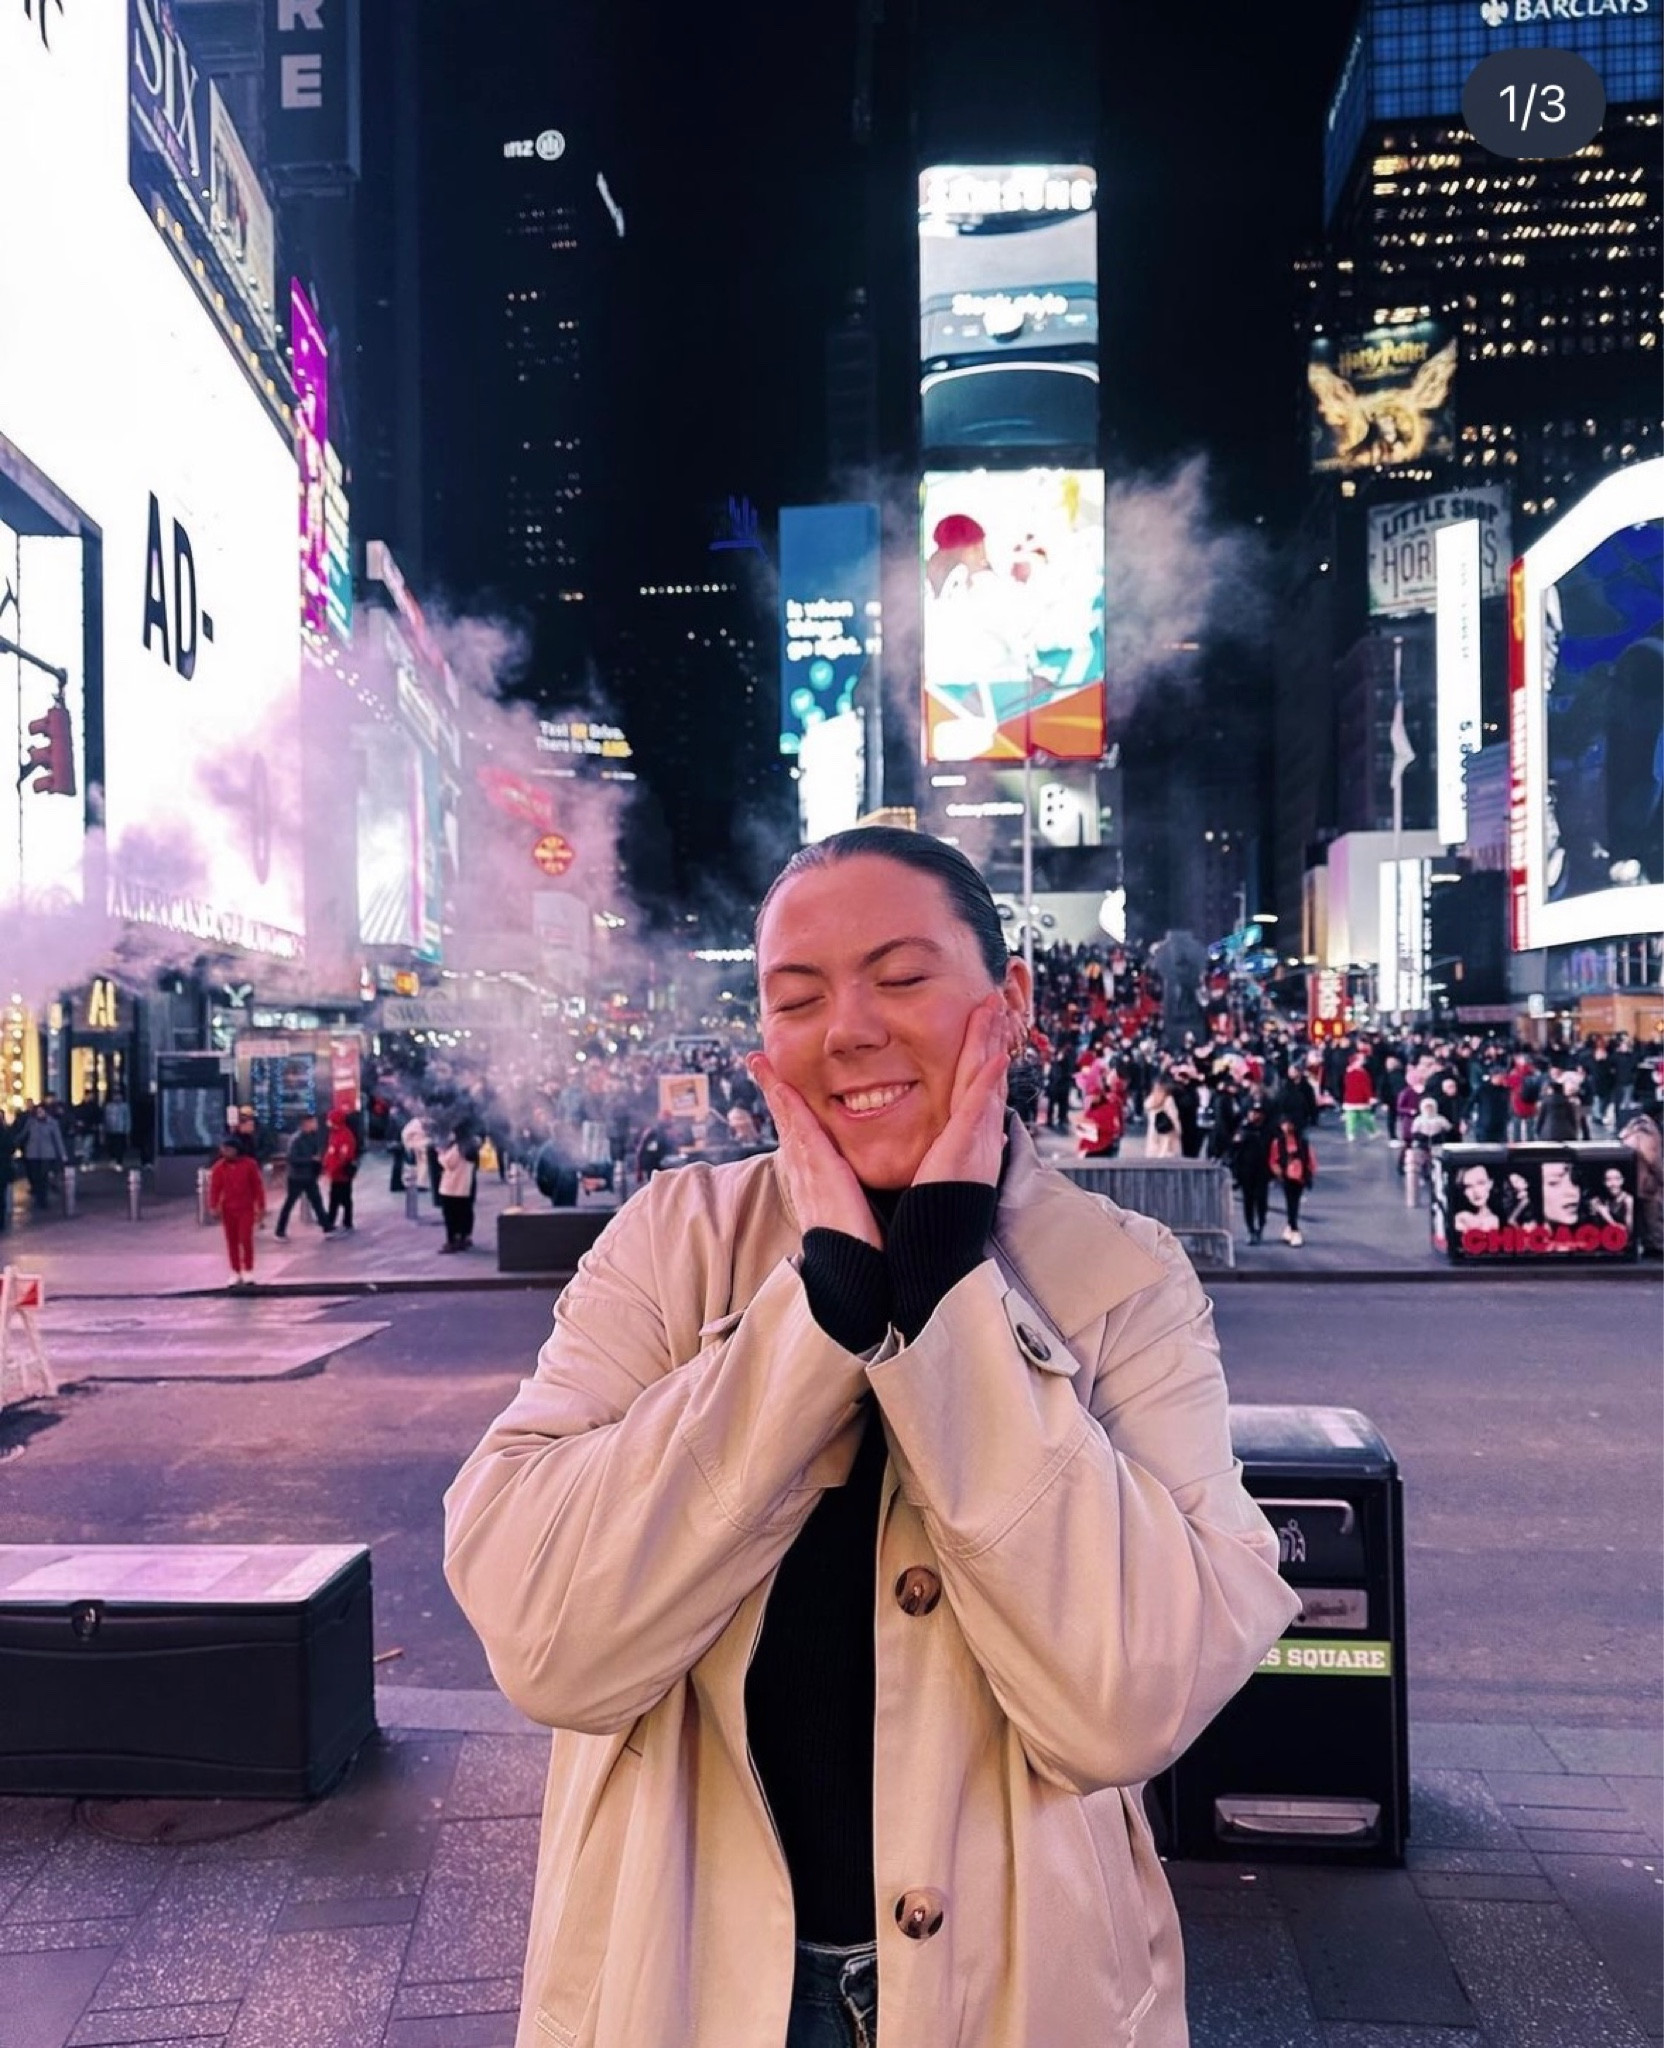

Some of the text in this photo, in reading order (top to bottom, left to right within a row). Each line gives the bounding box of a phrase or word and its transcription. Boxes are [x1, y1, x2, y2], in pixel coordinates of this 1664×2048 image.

[1382, 497, 1499, 541] LITTLE SHOP
[1462, 1223, 1628, 1254] CHICAGO
[1287, 1648, 1386, 1670] SQUARE
